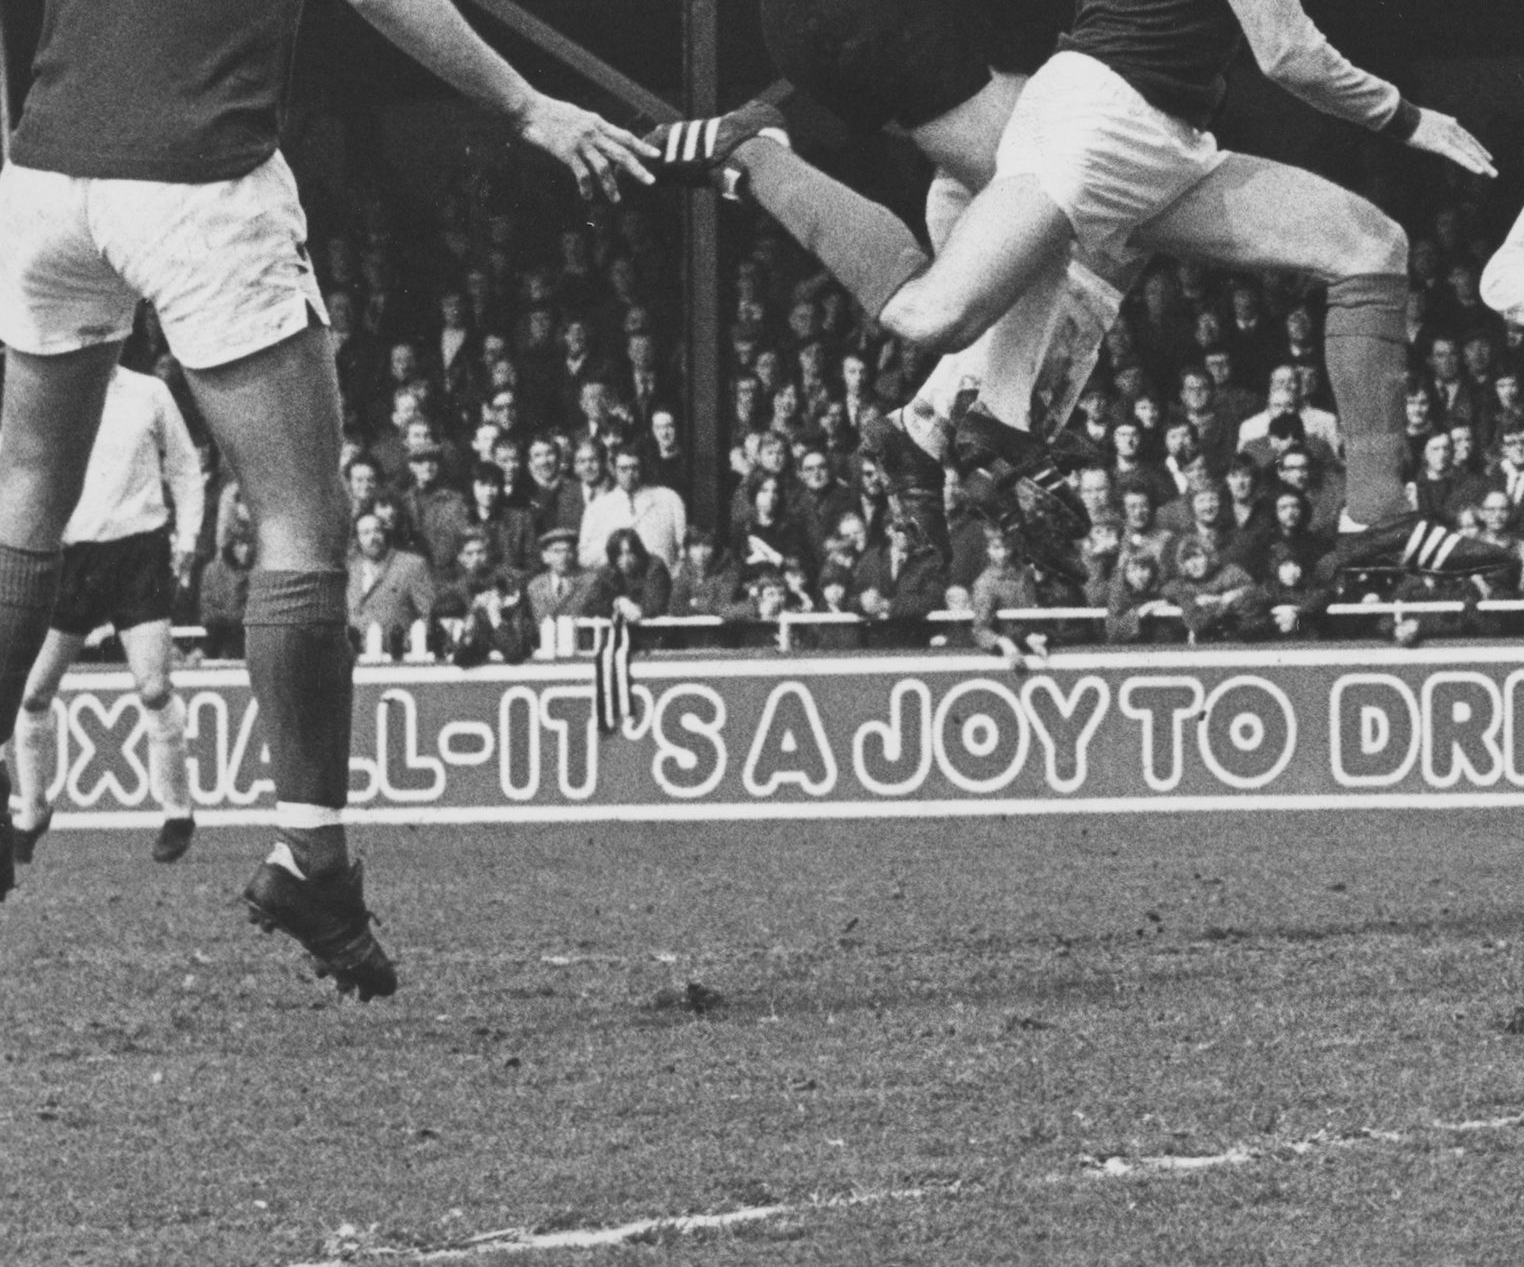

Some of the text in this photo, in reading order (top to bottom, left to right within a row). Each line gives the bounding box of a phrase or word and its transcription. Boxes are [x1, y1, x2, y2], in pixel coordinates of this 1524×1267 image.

[743, 681, 837, 796] A
[853, 675, 1110, 794] JOY
[1119, 675, 1298, 790] TO
